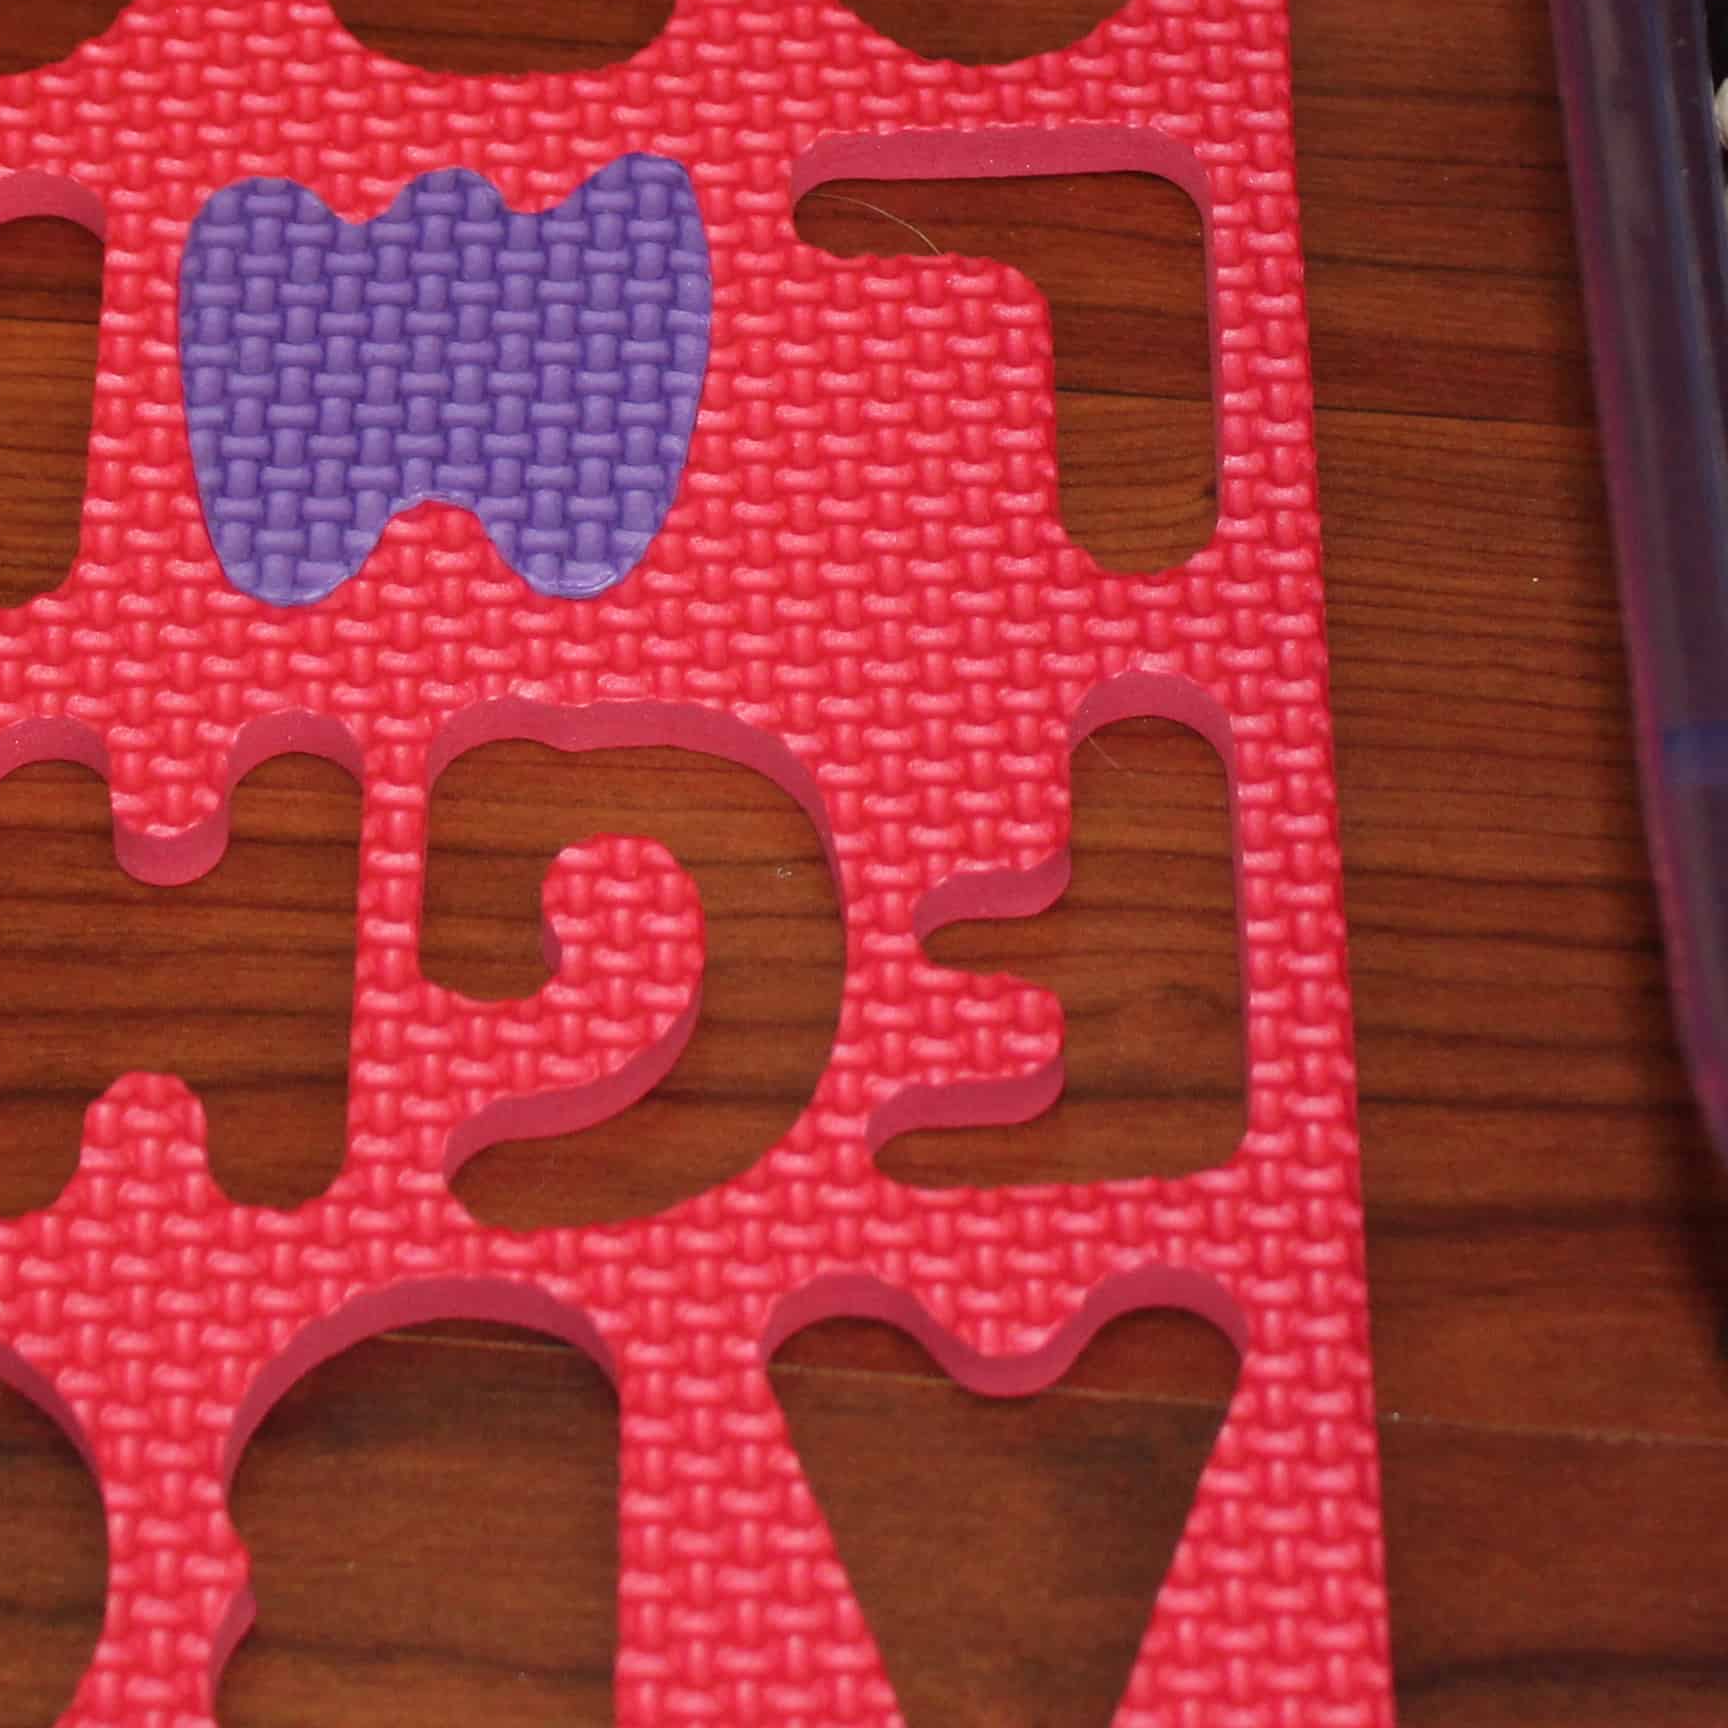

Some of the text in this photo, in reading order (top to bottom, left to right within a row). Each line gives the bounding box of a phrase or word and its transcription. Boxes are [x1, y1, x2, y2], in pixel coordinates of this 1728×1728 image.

[789, 127, 1224, 575] L
[419, 699, 849, 1227] G
[867, 672, 1252, 1187] F
[767, 1272, 1252, 1728] A
